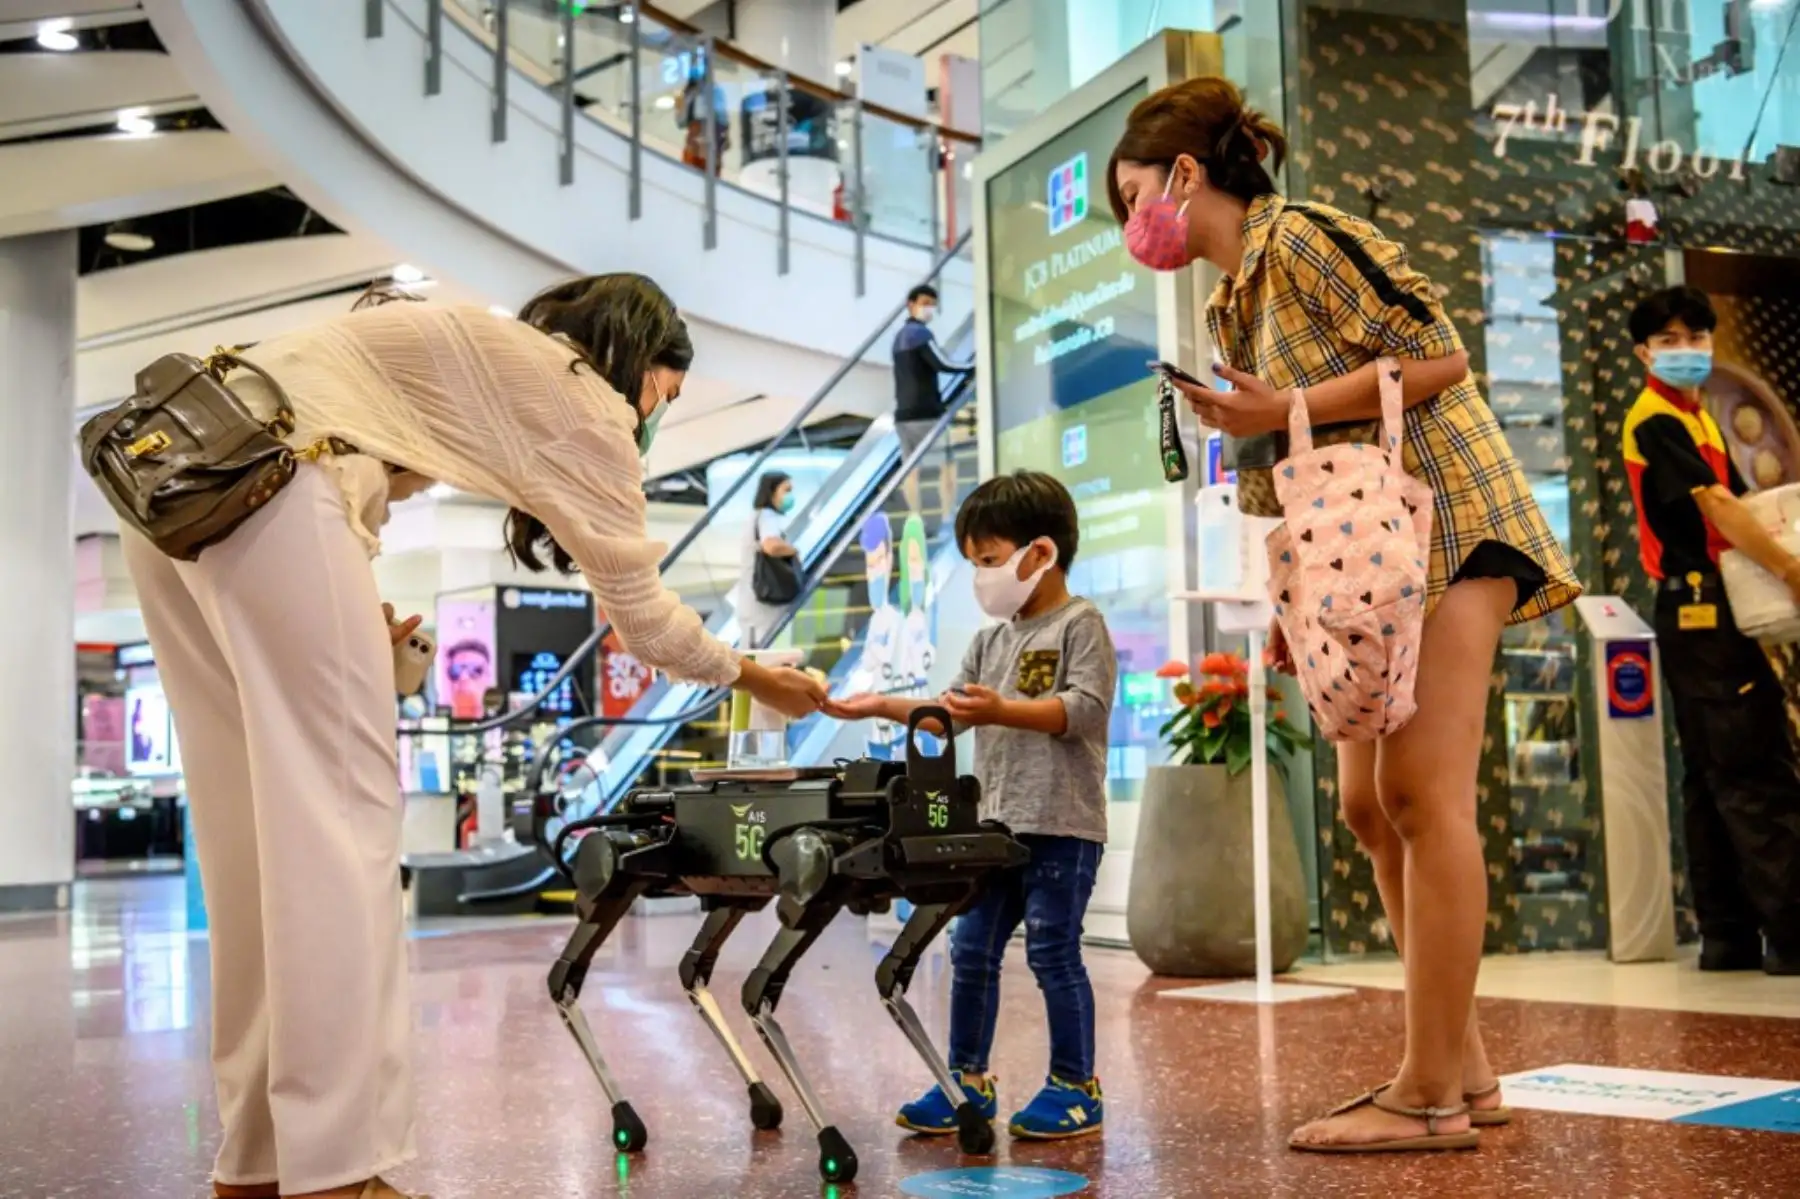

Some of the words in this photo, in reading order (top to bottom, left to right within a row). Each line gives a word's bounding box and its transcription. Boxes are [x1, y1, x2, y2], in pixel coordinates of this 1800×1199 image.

[1491, 93, 1568, 158] 7th
[1573, 111, 1757, 181] Floor
[748, 811, 767, 823] AIS
[927, 803, 949, 828] 5G
[735, 824, 765, 861] 5G
